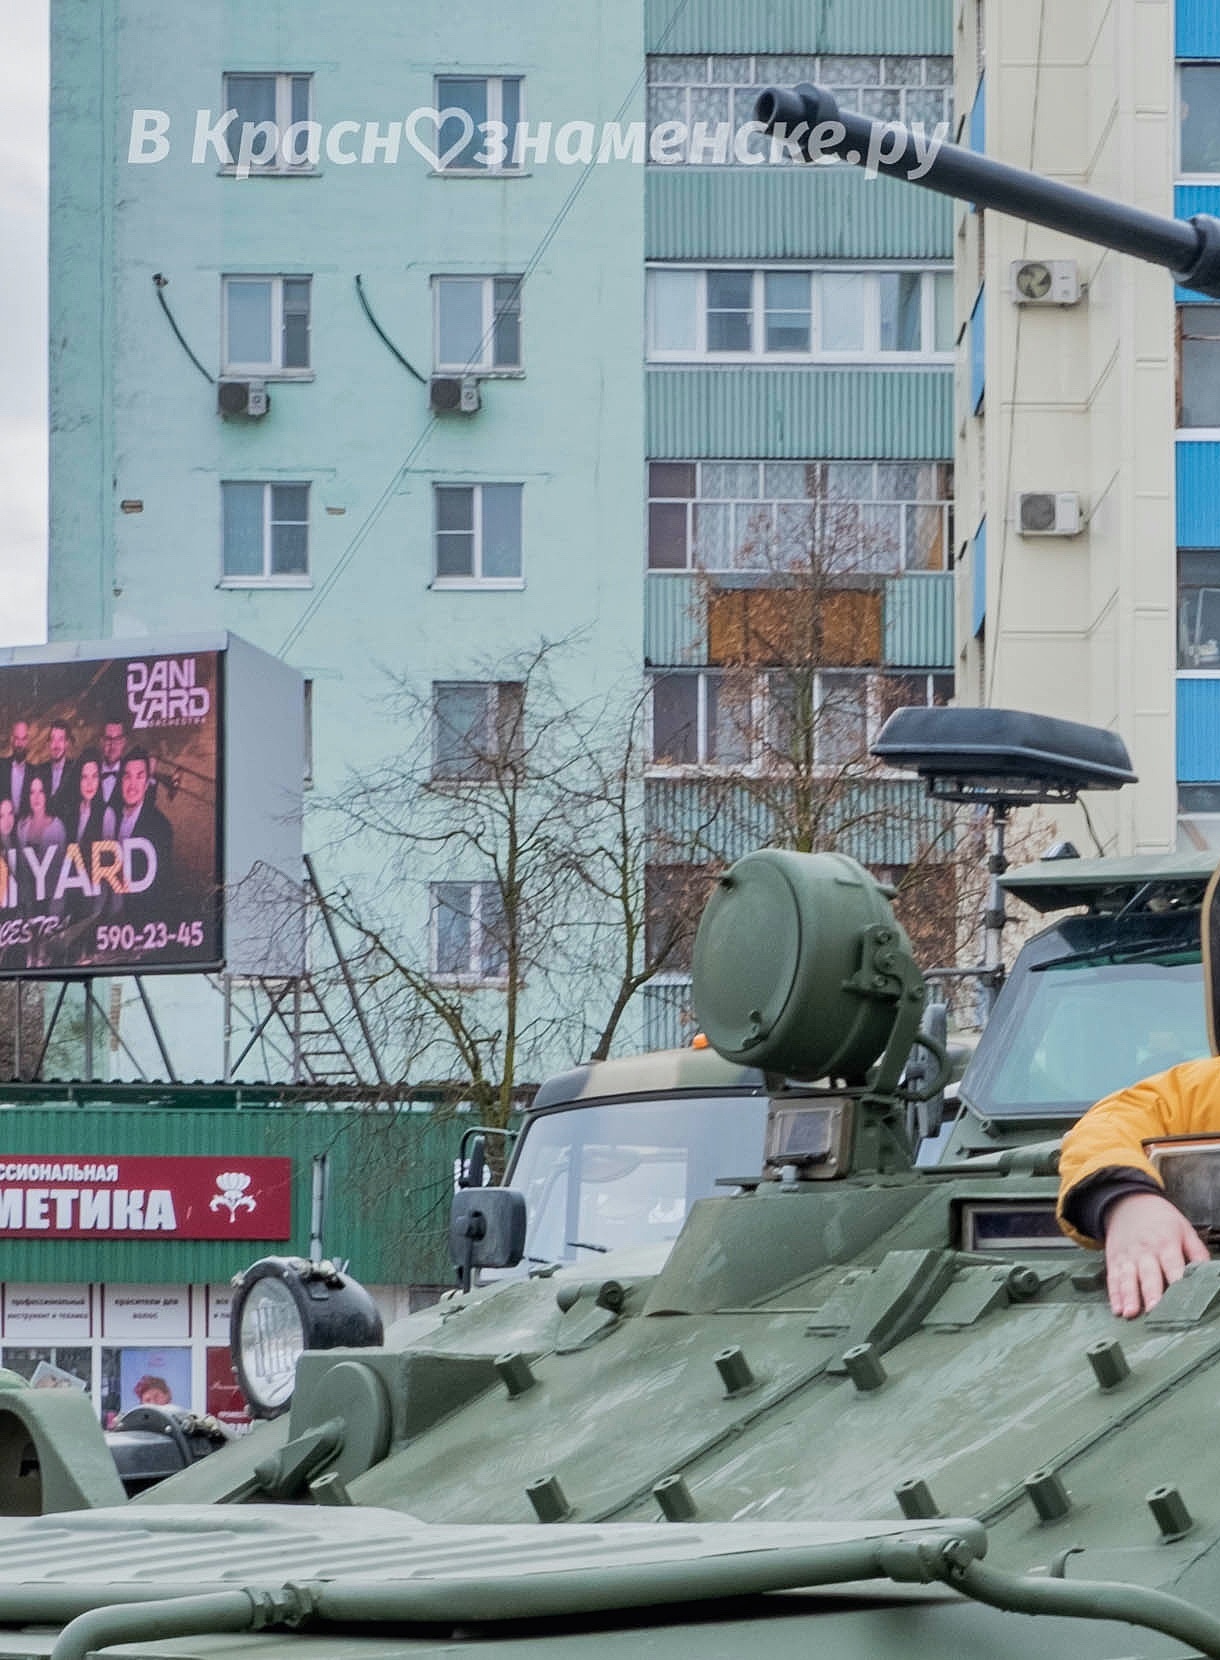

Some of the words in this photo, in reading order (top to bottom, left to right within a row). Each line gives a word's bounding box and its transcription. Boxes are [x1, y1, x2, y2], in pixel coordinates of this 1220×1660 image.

[126, 658, 196, 699] DANI
[127, 686, 210, 729] YARD
[96, 921, 204, 951] 590-23-45
